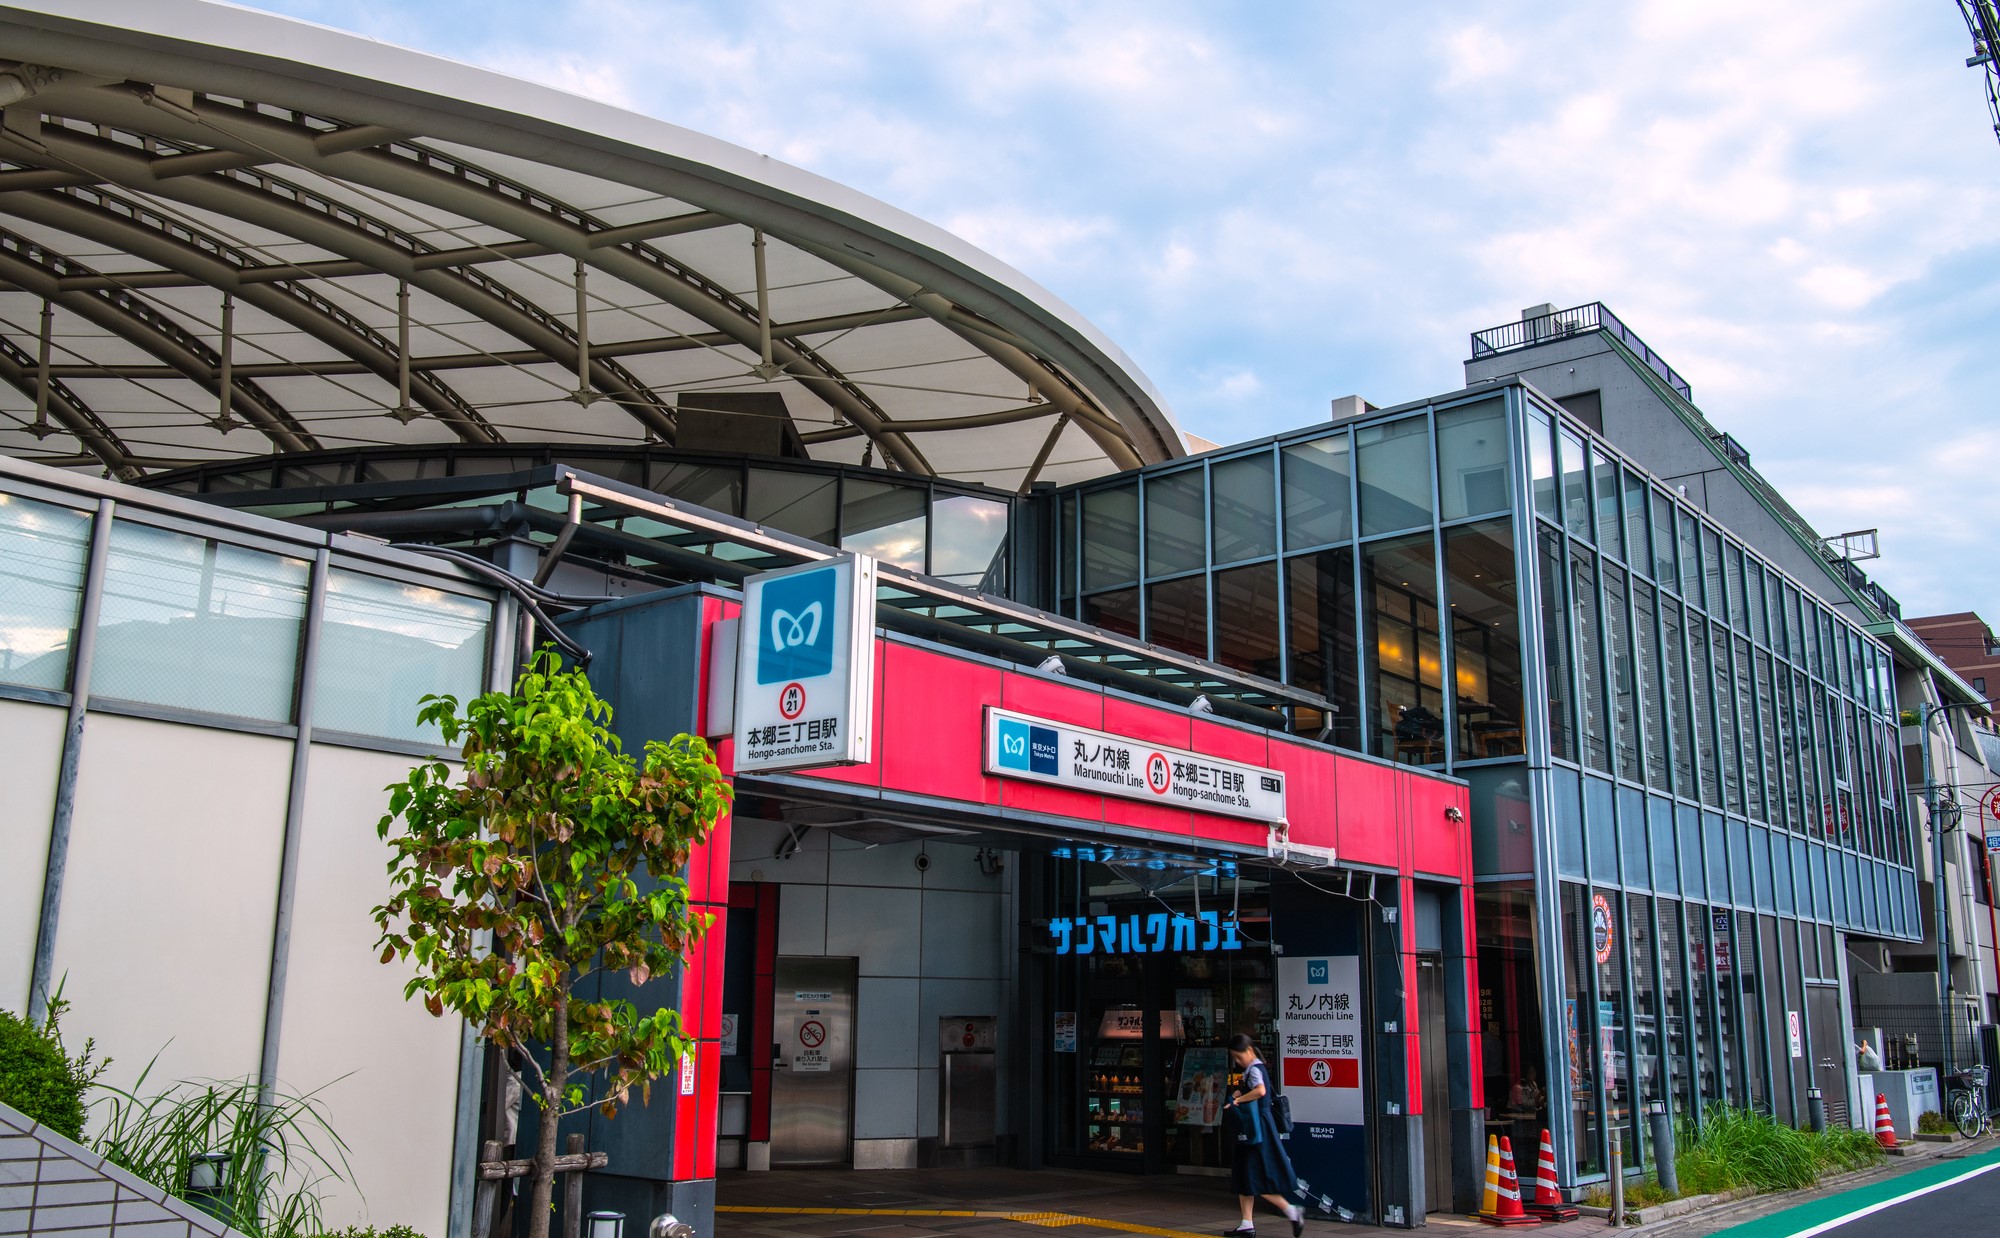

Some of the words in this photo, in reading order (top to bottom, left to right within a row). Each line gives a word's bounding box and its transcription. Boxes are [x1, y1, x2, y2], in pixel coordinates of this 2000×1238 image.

[788, 689, 797, 699] M
[786, 700, 798, 712] 21
[747, 718, 837, 748] 本郷三丁目駅
[748, 742, 817, 760] Hongo-sanchome
[820, 740, 834, 752] Sta.
[1032, 742, 1056, 754] 東京メトロ
[1074, 739, 1130, 770] 丸ノ内線
[1154, 760, 1163, 770] M
[1074, 762, 1125, 786] Marunouchi
[1126, 772, 1144, 788] Line
[1153, 772, 1164, 786] 21
[1172, 760, 1245, 794] 本郷三丁目駅
[1274, 780, 1278, 791] 1
[1172, 782, 1236, 806] Hongo-sanchome
[1238, 793, 1251, 808] Sta.
[1049, 910, 1242, 955] サンマルクカフェ
[1288, 993, 1350, 1011] 丸ノ内線
[1285, 1011, 1334, 1020] Marunouchi
[1336, 1011, 1354, 1020] Line
[1286, 1034, 1354, 1048] 本郷三丁目駅
[1287, 1048, 1339, 1057] Hongo-sanchome
[1314, 1071, 1326, 1081] 21
